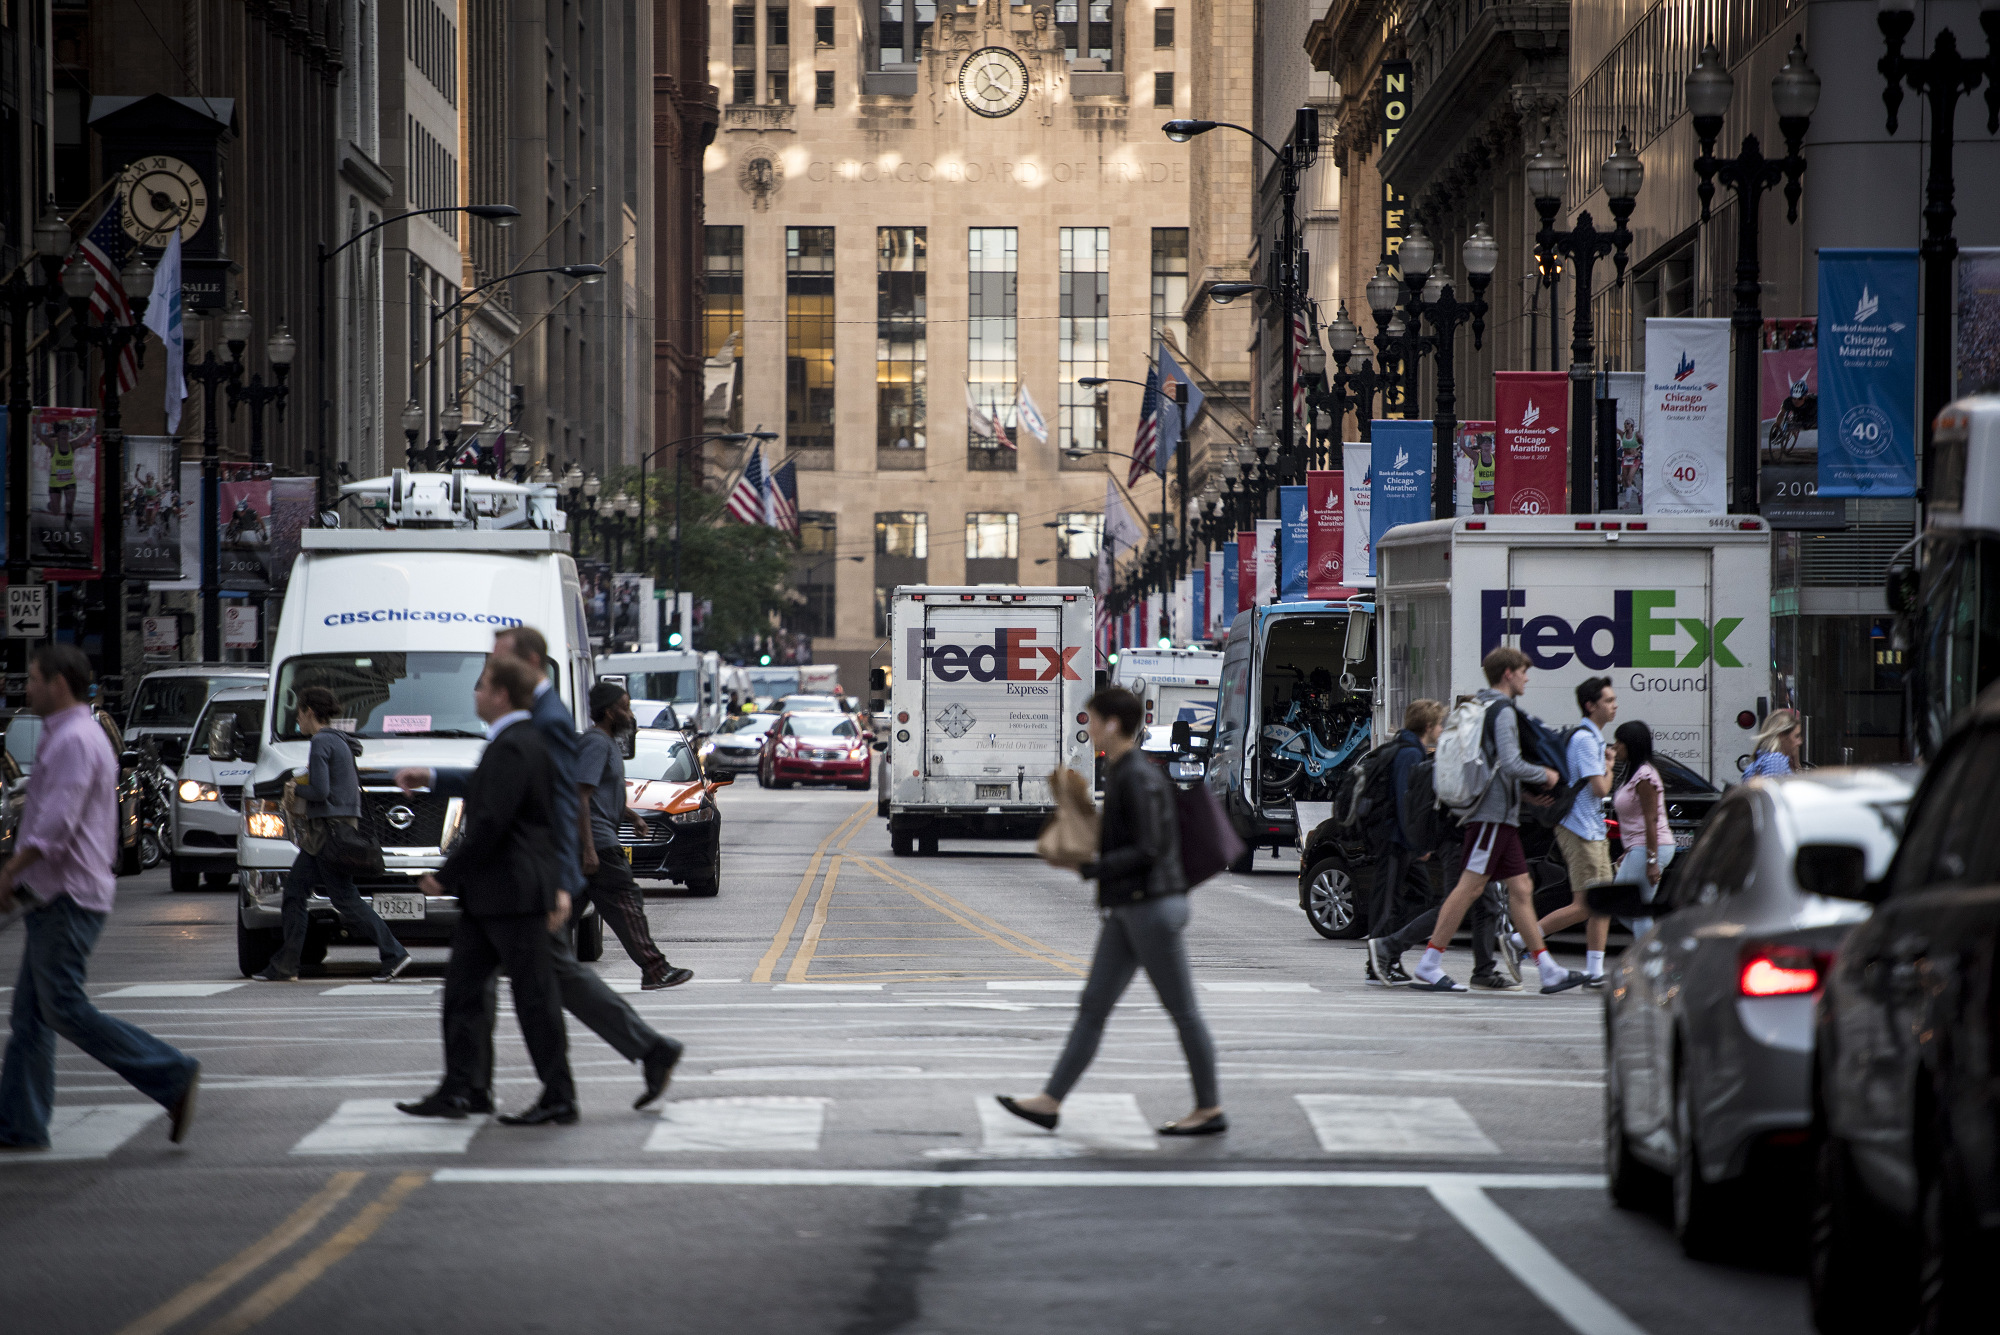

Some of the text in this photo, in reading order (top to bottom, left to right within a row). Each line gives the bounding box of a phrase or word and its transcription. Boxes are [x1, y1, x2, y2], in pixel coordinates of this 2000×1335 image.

[807, 162, 1185, 183] CHICAGO BOARD OF TRADE
[182, 283, 220, 292] SALLE
[1831, 324, 1849, 332] Bank
[1857, 324, 1887, 332] America
[1844, 334, 1887, 348] Chicago
[1839, 345, 1893, 357] Marathon
[1665, 393, 1702, 404] Chicago
[1661, 403, 1707, 412] Marathon
[1852, 422, 1879, 440] 40
[1514, 436, 1546, 445] Chicago
[1673, 467, 1696, 481] 40
[1387, 477, 1414, 485] Chicago
[1776, 482, 1815, 496] 200
[1520, 501, 1539, 514] 40
[42, 531, 82, 543] 2015
[134, 548, 171, 558] 2014
[1325, 561, 1339, 570] 40
[10, 590, 41, 603] ONE
[10, 605, 42, 616] WAY
[324, 608, 523, 628] CBSChicago.com
[1481, 589, 1745, 670] FedEx
[907, 628, 1083, 682] FedEx
[1630, 673, 1707, 692] Ground
[1006, 683, 1049, 696] Express
[1009, 711, 1049, 720] fedex.com
[1650, 729, 1700, 741] dex.com
